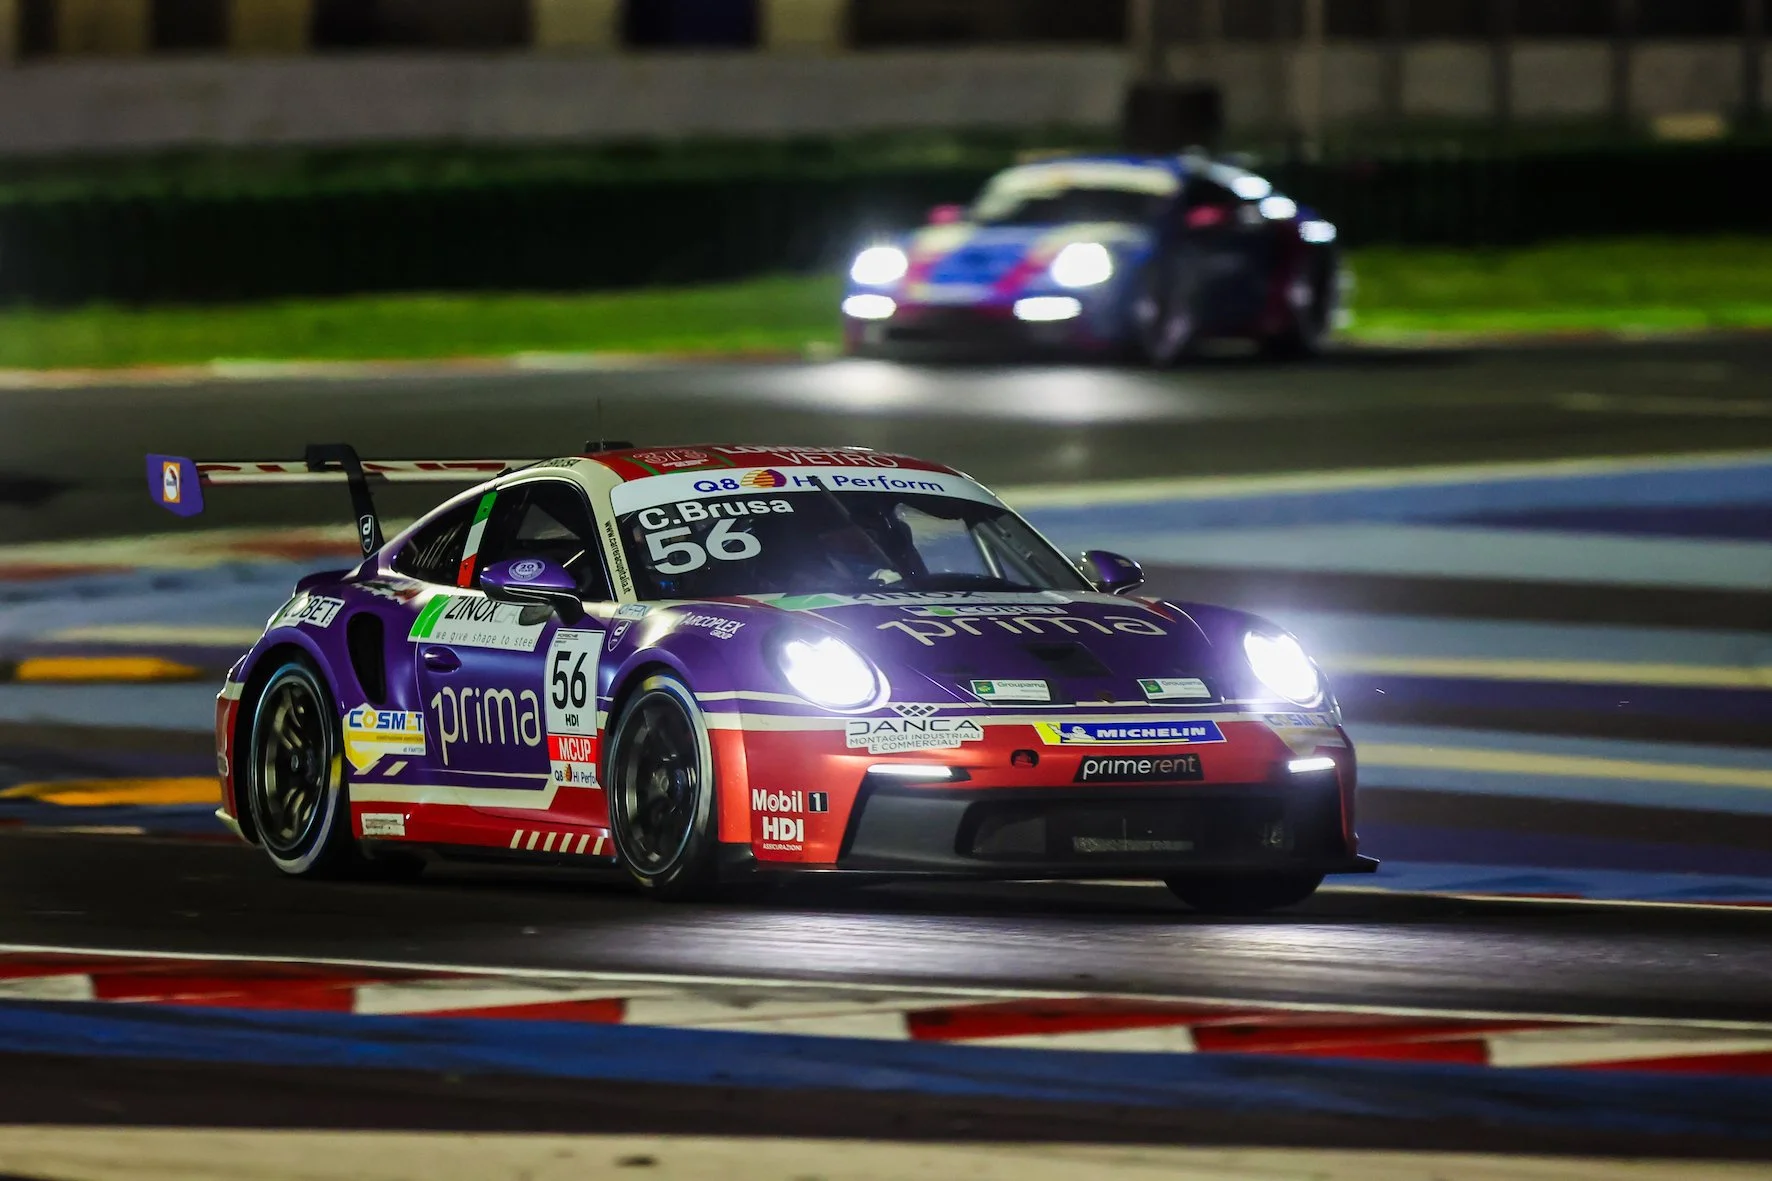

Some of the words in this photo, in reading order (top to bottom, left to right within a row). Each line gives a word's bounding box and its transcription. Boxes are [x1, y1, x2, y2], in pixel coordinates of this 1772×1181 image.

[769, 452, 899, 468] VETRO
[693, 478, 740, 492] Q8
[831, 475, 945, 492] Perform
[638, 499, 794, 530] C.Brusa
[645, 518, 762, 575] 56
[435, 631, 447, 640] we
[450, 633, 467, 643] give
[473, 635, 496, 645] shape
[876, 616, 1167, 646] prima
[552, 650, 588, 710] 56
[349, 710, 423, 732] COSMET
[431, 686, 541, 766] prima
[565, 713, 579, 727] HDI
[850, 734, 908, 746] MONTAGGI
[911, 732, 980, 740] INDUSTRIALI
[1096, 727, 1206, 739] MICHELIN
[558, 737, 591, 762] MCUP
[881, 740, 958, 750] COMMERCIALI
[573, 772, 580, 782] Hi
[1083, 755, 1196, 780] primerent
[752, 788, 803, 813] Mobil
[762, 816, 804, 842] HDI
